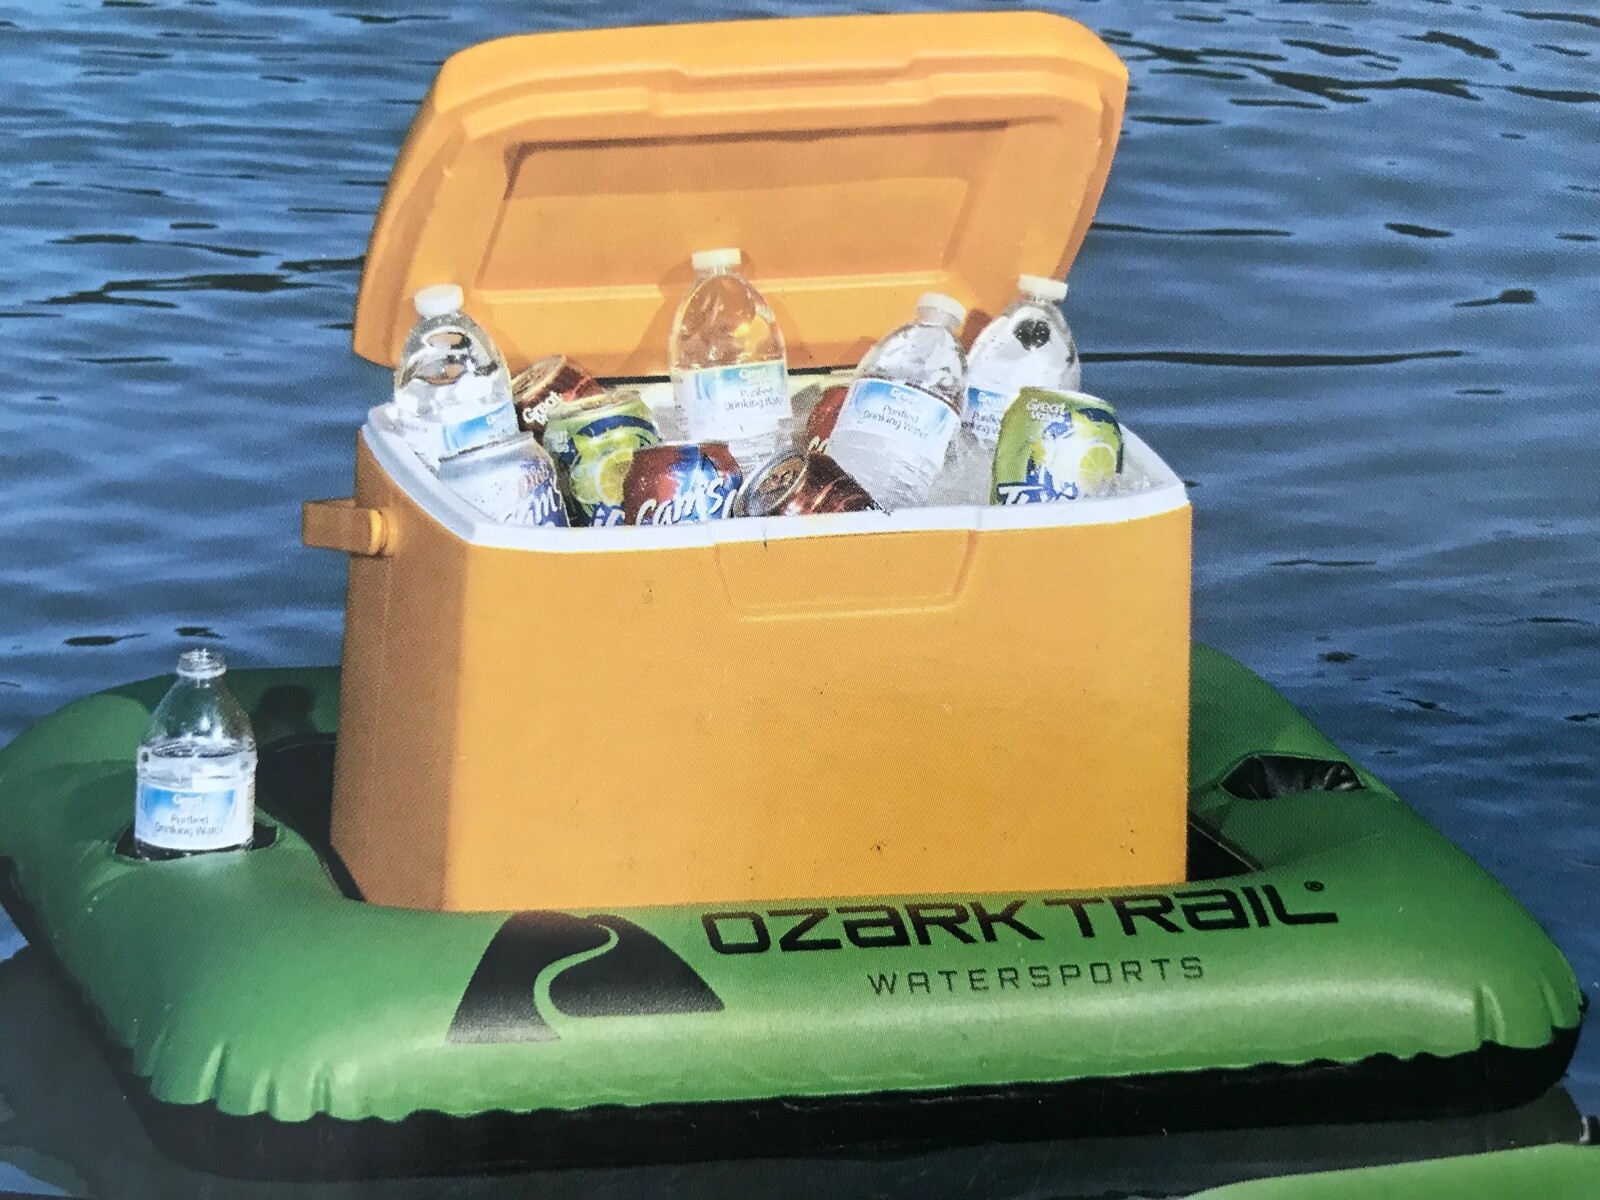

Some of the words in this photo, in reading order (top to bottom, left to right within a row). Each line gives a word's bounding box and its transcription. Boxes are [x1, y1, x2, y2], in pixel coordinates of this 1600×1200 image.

[724, 399, 765, 412] Drinking
[882, 403, 919, 423] Purified
[863, 409, 902, 430] Drinking
[903, 421, 929, 440] Water
[170, 813, 209, 825] Purified
[155, 821, 193, 838] Drinking
[195, 825, 224, 836] Water
[867, 956, 1204, 996] WATERSPORTS
